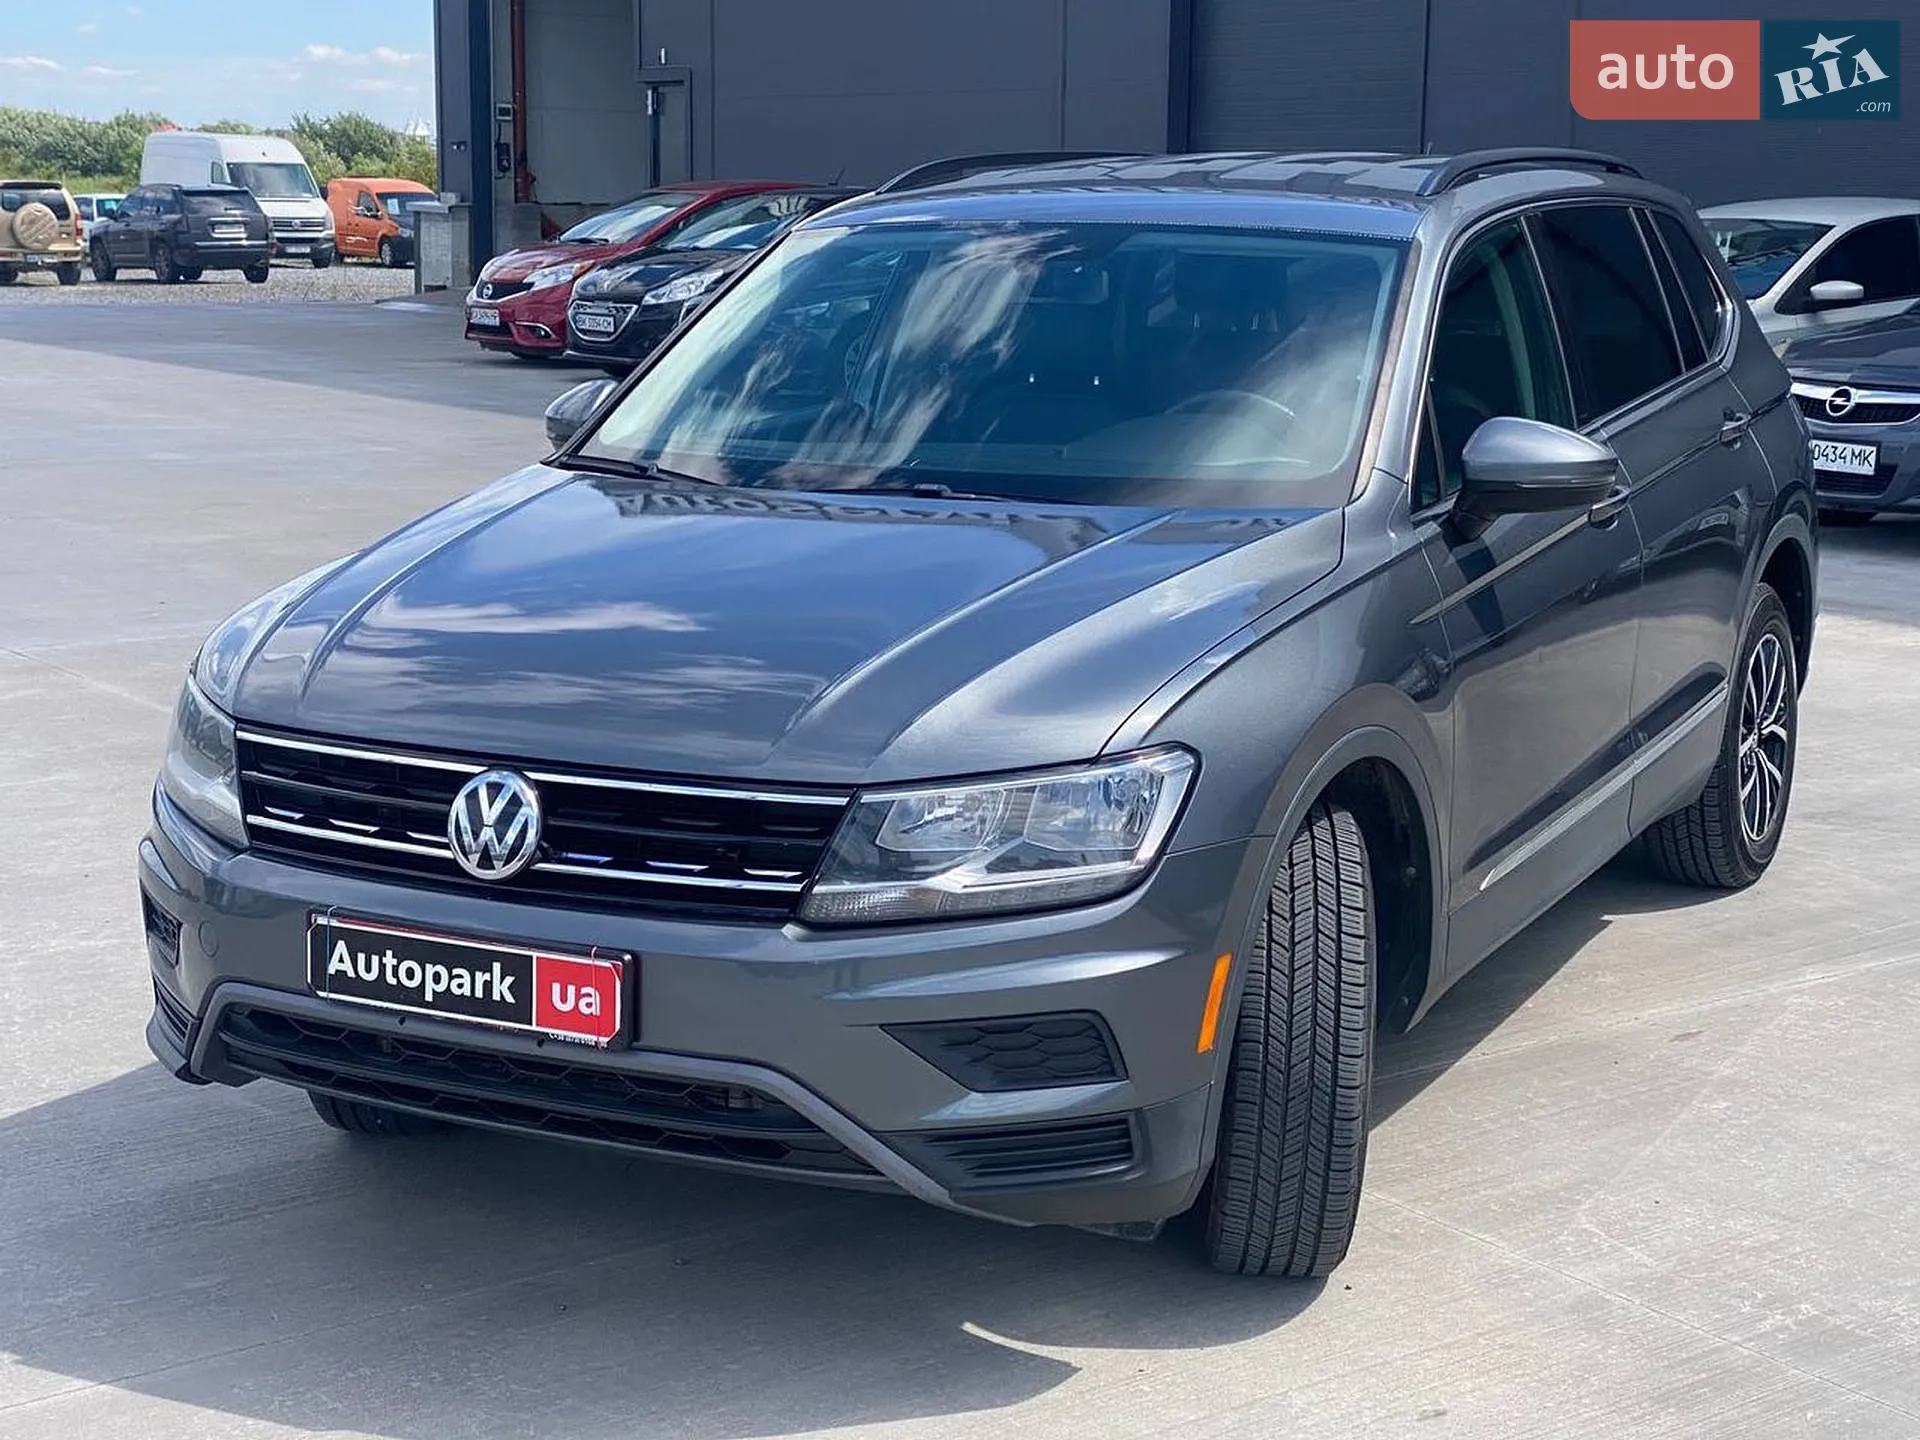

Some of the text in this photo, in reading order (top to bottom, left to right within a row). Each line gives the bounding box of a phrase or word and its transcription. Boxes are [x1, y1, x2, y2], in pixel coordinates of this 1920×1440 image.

[1813, 444, 1874, 467] 0434 MK
[328, 940, 601, 1017] Autopark ua
